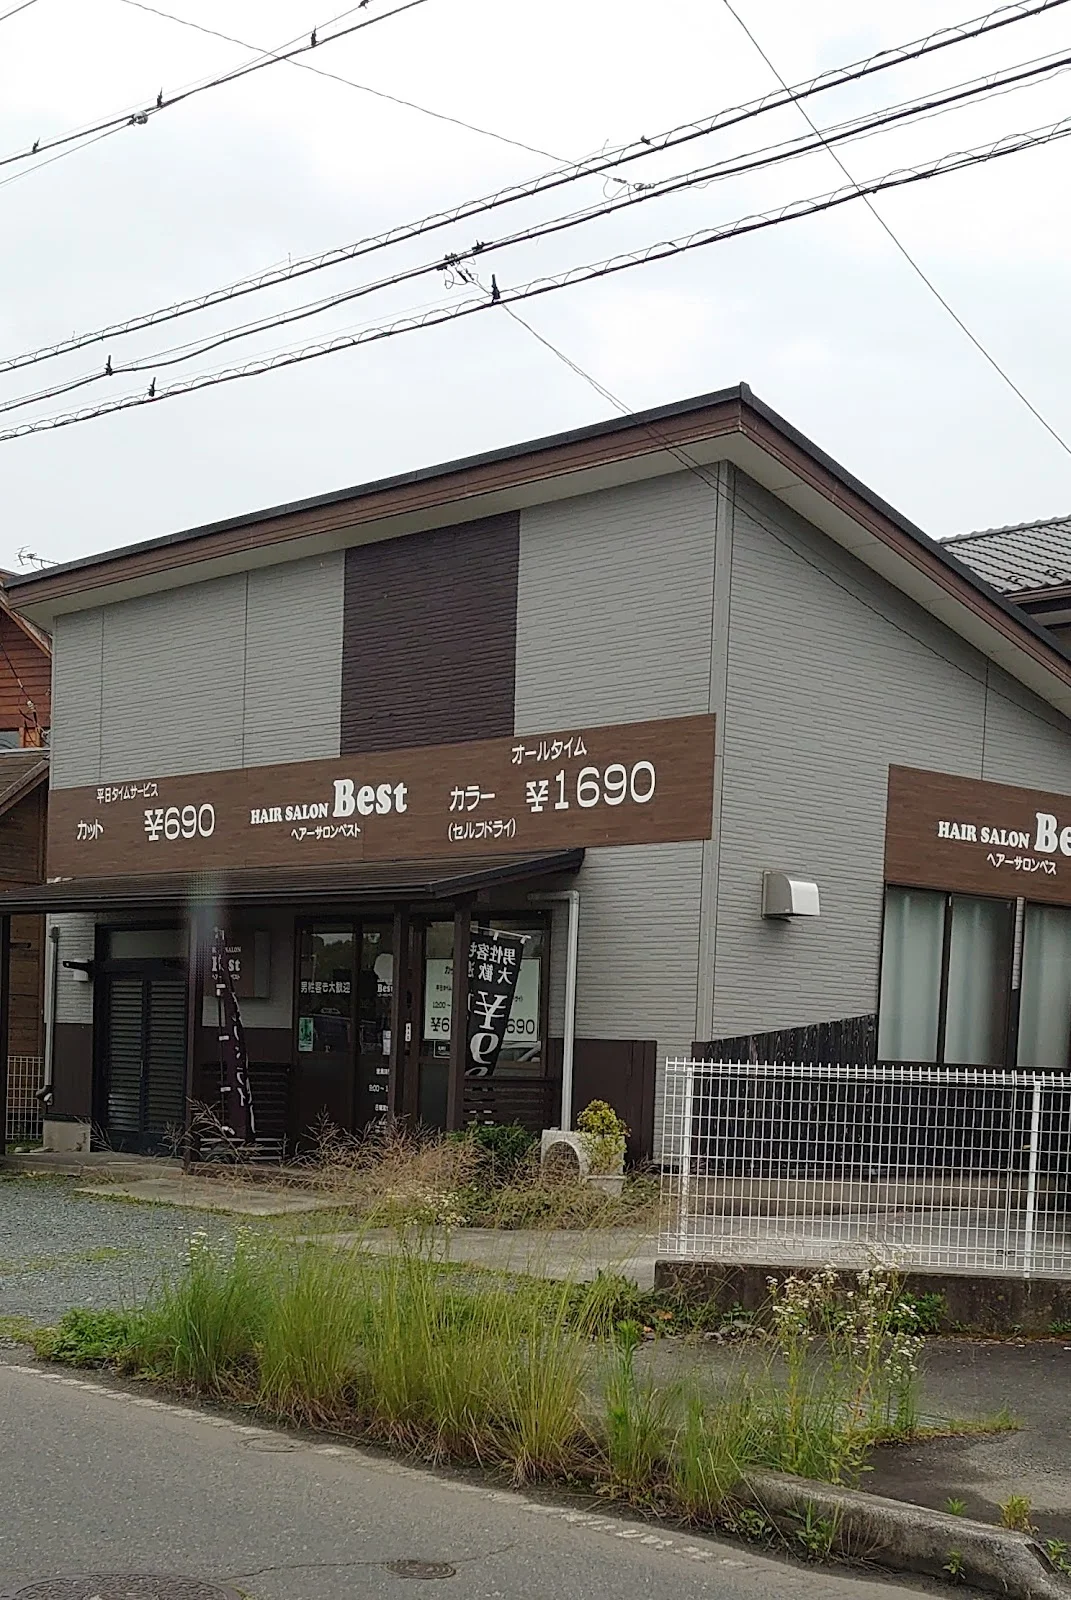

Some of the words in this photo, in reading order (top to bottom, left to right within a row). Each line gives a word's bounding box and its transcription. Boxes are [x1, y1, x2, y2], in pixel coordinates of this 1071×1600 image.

[511, 736, 587, 764] オールタイム
[96, 782, 159, 804] 平日タイムサービス
[250, 807, 283, 824] HAIR
[284, 803, 329, 821] SALON
[332, 779, 408, 818] Best
[449, 785, 496, 812] カラー
[76, 818, 104, 841] カット
[144, 803, 215, 841] ¥690
[290, 822, 361, 841] ヘアーサロンベスト
[937, 821, 978, 843] HAIR
[980, 827, 1030, 849] SALON
[986, 852, 1057, 875] ヘアーサロンベス
